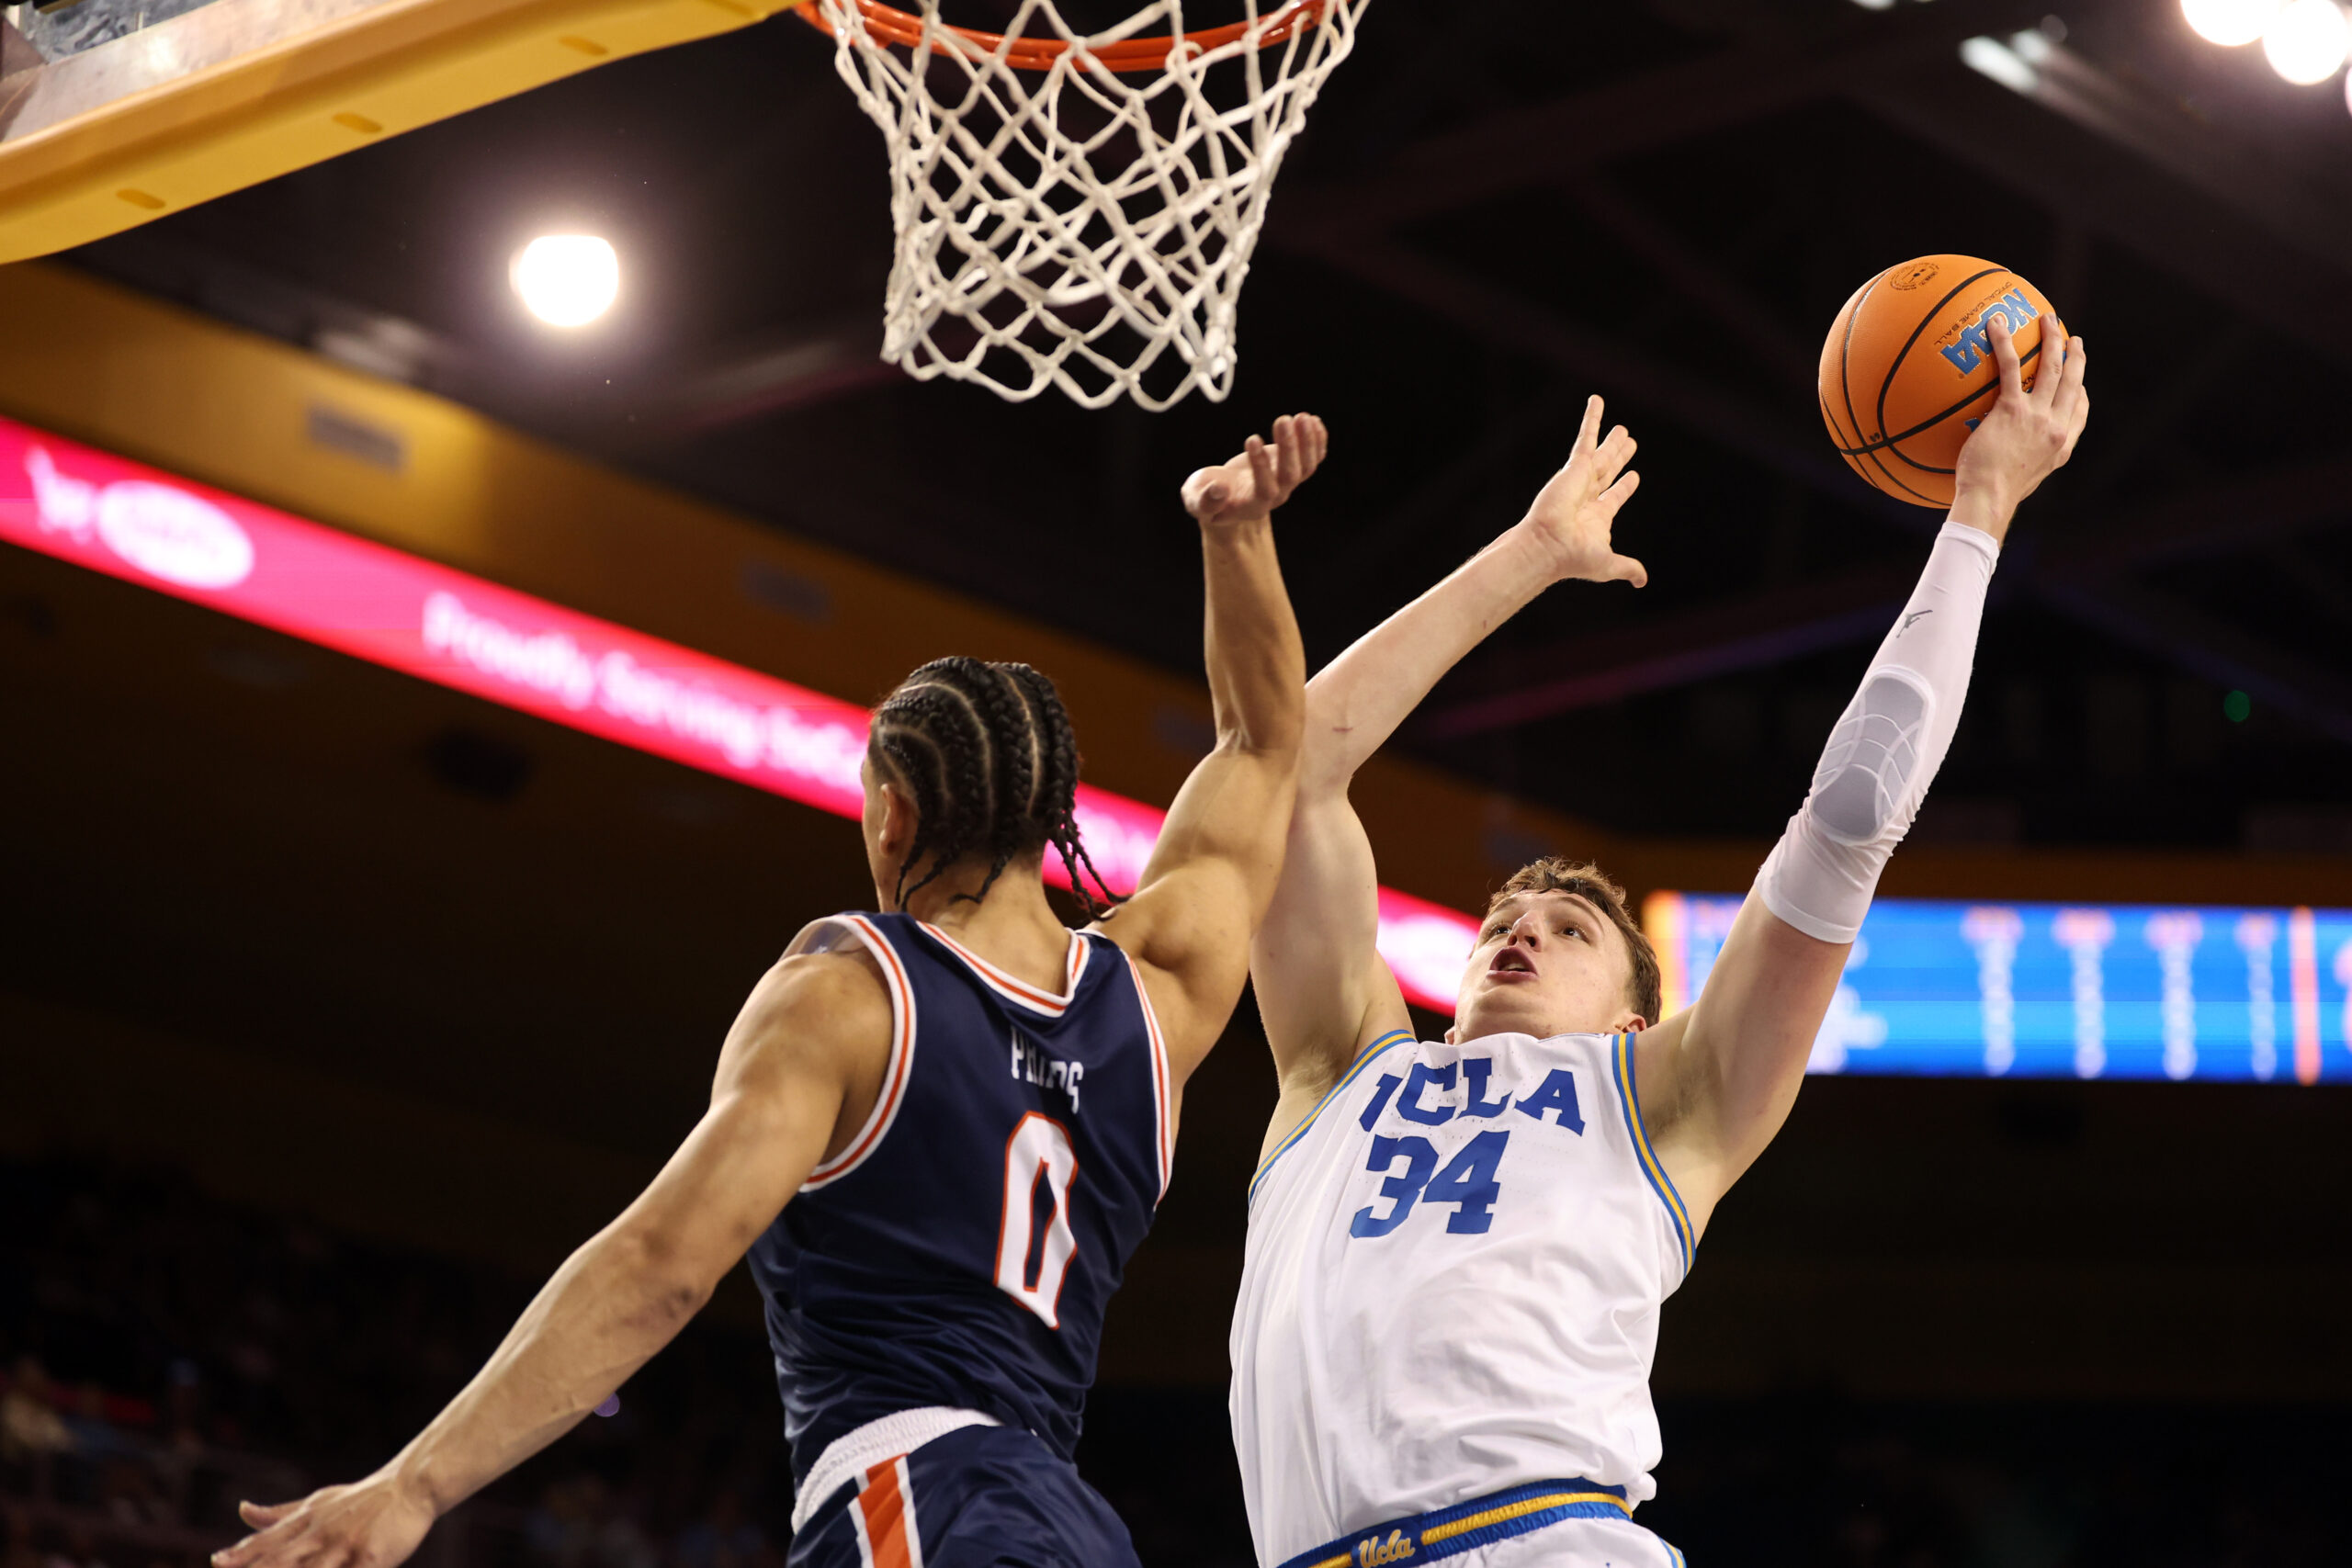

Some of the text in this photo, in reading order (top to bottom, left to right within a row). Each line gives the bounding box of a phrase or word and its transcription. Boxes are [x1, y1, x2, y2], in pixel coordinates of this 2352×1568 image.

[1933, 322, 1961, 346] BALL
[1939, 287, 2040, 375] NCAA
[994, 1110, 1079, 1330] 0
[1349, 1129, 1510, 1239] 34
[1358, 1529, 1417, 1568] Ucla
